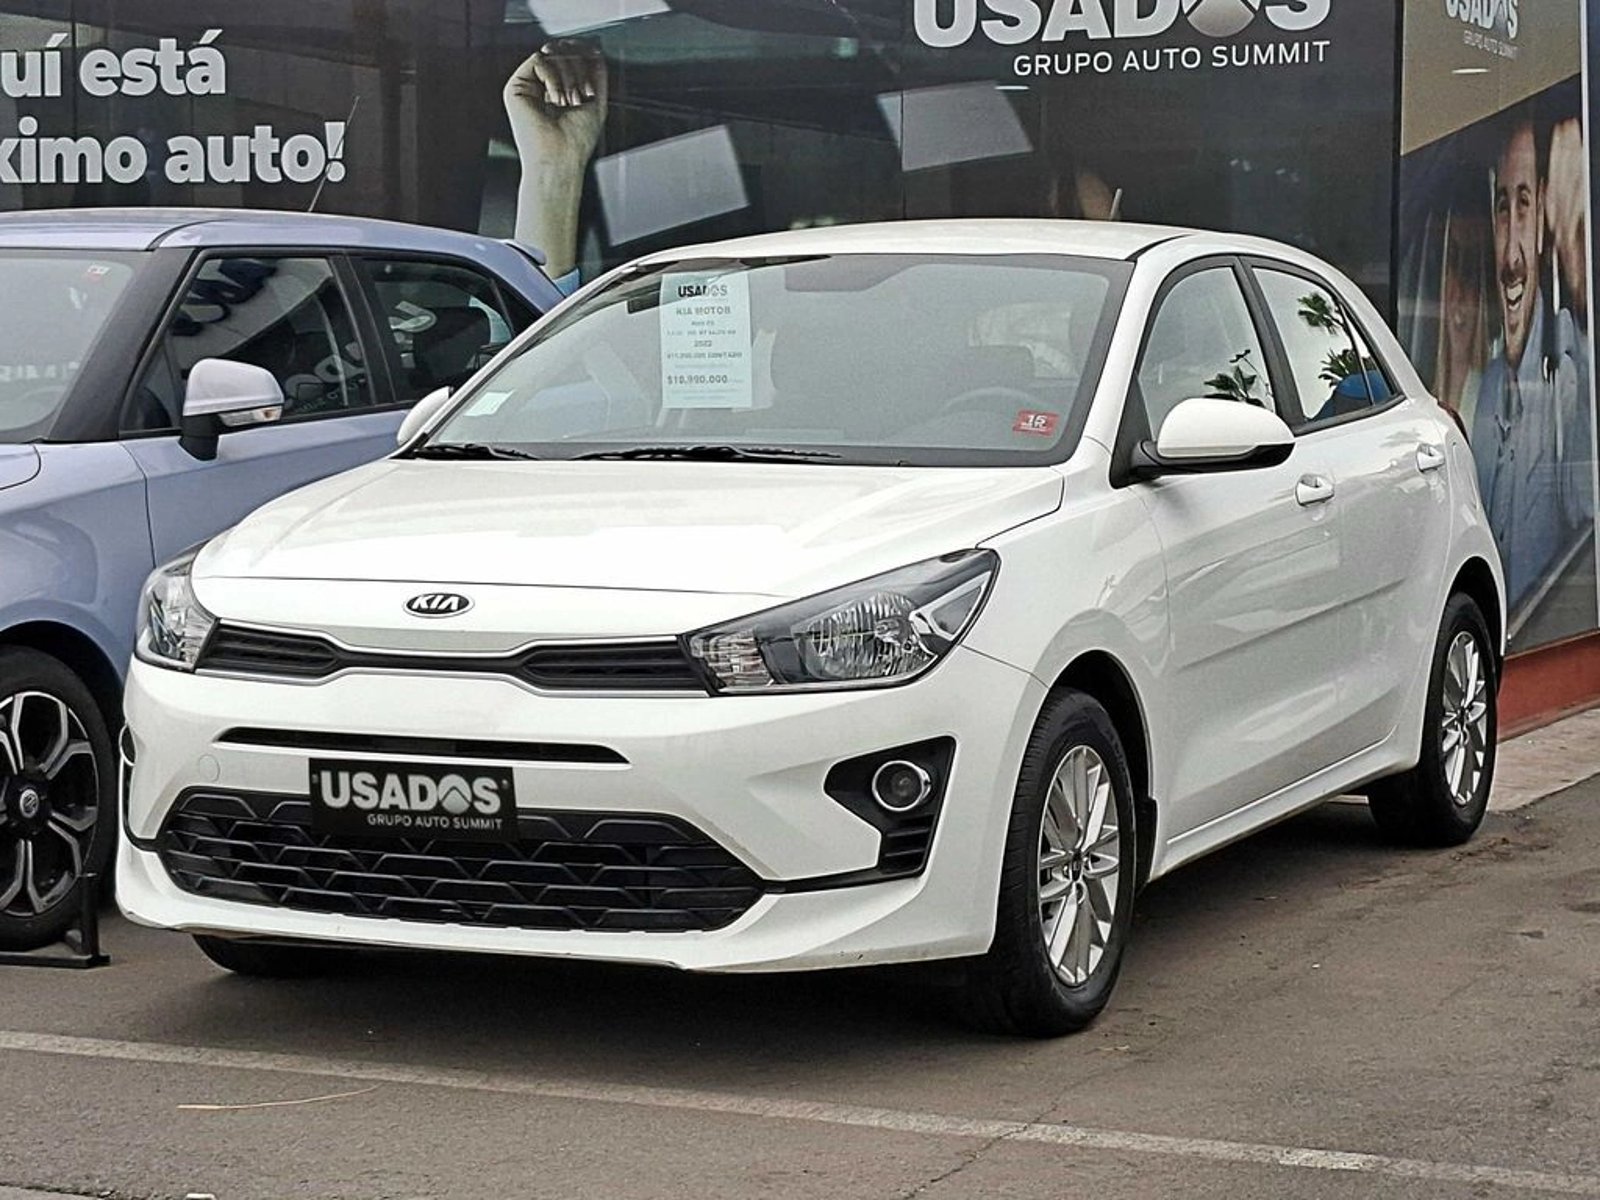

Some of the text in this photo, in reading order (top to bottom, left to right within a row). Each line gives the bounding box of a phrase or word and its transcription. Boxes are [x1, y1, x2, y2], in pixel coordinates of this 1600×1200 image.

[79, 29, 226, 96] está
[1013, 40, 1331, 76] GRUPO AUTO SUMMIT
[165, 121, 347, 183] auto!
[678, 285, 728, 298] USADOS
[411, 594, 460, 611] KIA
[320, 770, 501, 815] USADOS
[367, 814, 503, 830] GRUPO AUTO SUMMIT
